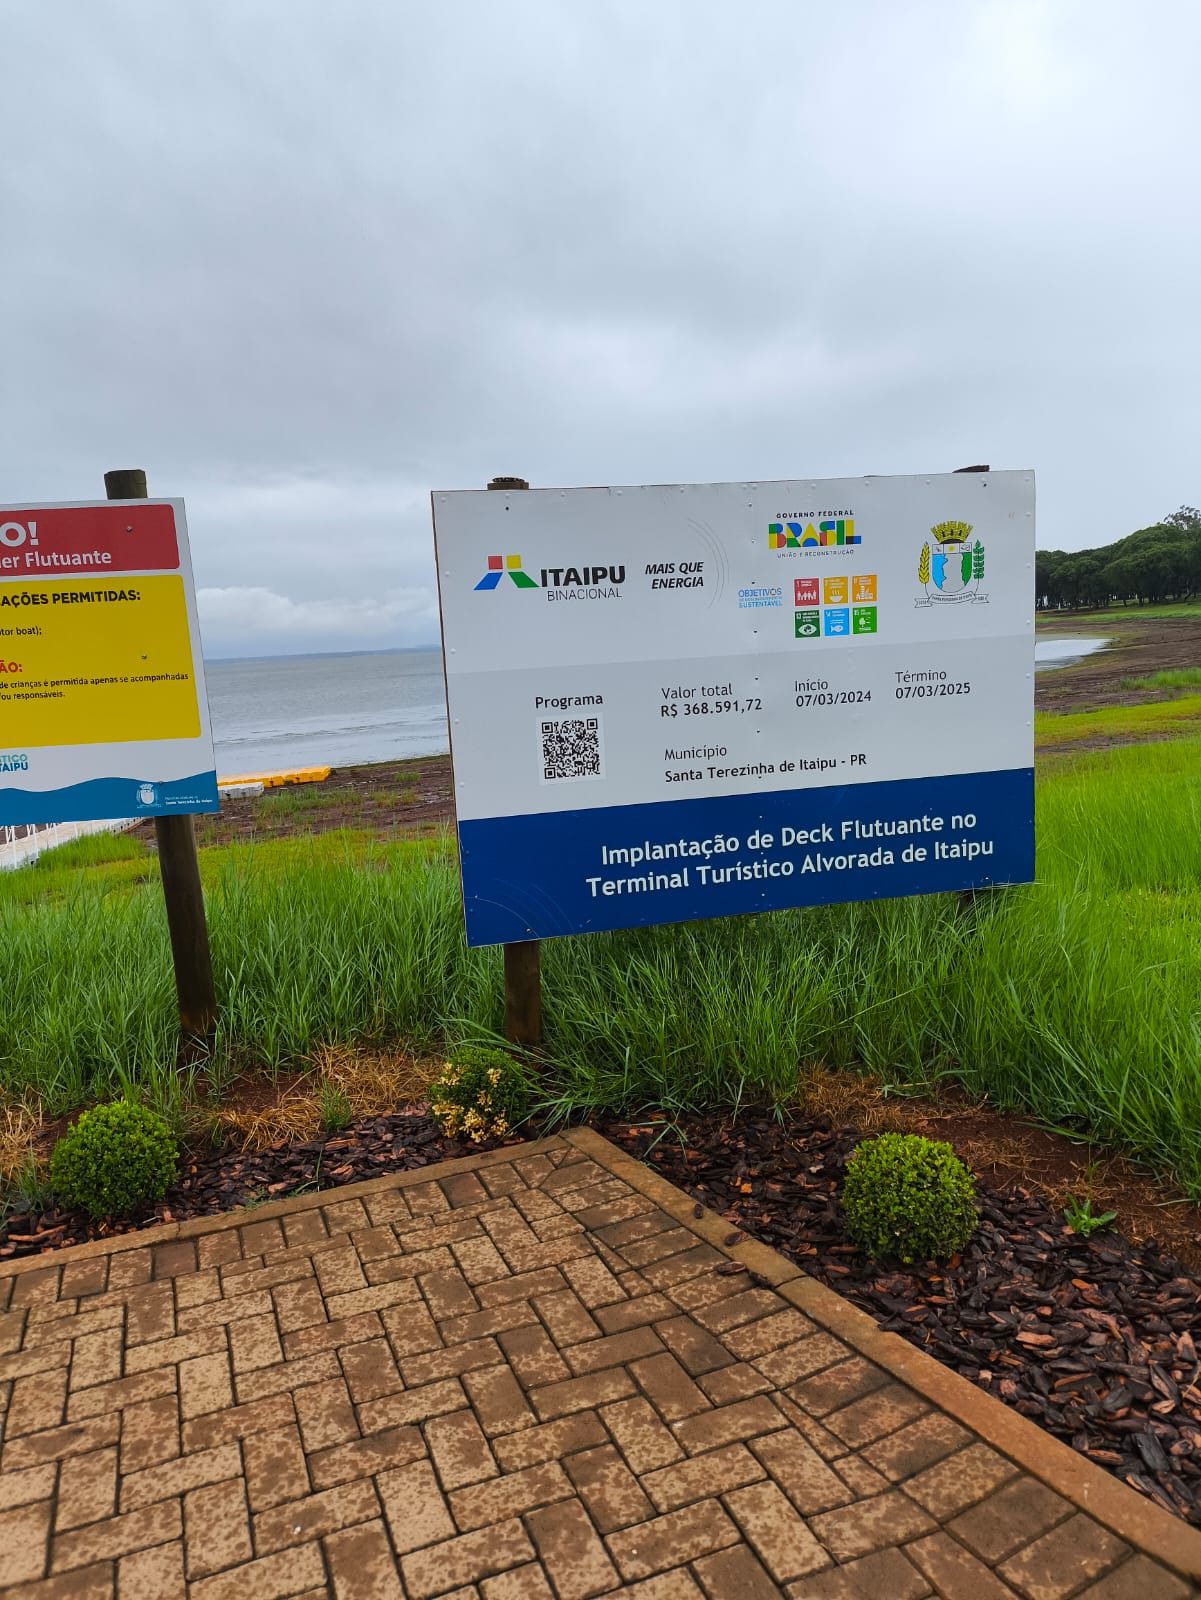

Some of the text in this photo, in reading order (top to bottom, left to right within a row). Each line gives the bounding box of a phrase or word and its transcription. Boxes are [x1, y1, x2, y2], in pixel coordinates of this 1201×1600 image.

[776, 509, 854, 519] GOVERNO FEDERAL
[768, 519, 862, 549] BRASIL
[0, 550, 112, 569] er Flutuante
[776, 551, 797, 559] UNIÃO
[805, 548, 855, 557] RECONSTRUÇÃO
[540, 565, 627, 587] ITAIPU
[645, 561, 705, 575] MAIS QUE
[651, 576, 705, 590] ENERGIA
[1, 589, 141, 608] AÇÕES PERMITIDAS:
[547, 587, 623, 601] BINACIONAL
[738, 587, 783, 598] OBJETIVOS
[0, 625, 42, 636] tor boat);
[10, 680, 42, 690] crianças
[50, 676, 89, 688] permitida
[90, 676, 118, 685] apenas
[119, 675, 129, 683] se
[130, 672, 189, 683] acompanhadas
[895, 669, 947, 683] Término
[661, 683, 733, 699] Valor total
[794, 678, 829, 693] Início
[896, 682, 971, 699] 07/03/2025
[535, 694, 604, 710] Programa
[796, 690, 872, 707] 07/03/2024
[661, 698, 763, 718] R$ 368.591,72
[0, 754, 28, 763] TICO
[664, 744, 728, 761] Município
[665, 767, 703, 783] Santa
[707, 762, 775, 779] Terezinha
[779, 760, 795, 772] de
[799, 757, 837, 772] Itaipu
[850, 753, 867, 766] PR
[602, 813, 977, 867] Implantação de Deck Flutuante no
[586, 838, 994, 897] Terminal Turístico Alvorada de Itaipu
